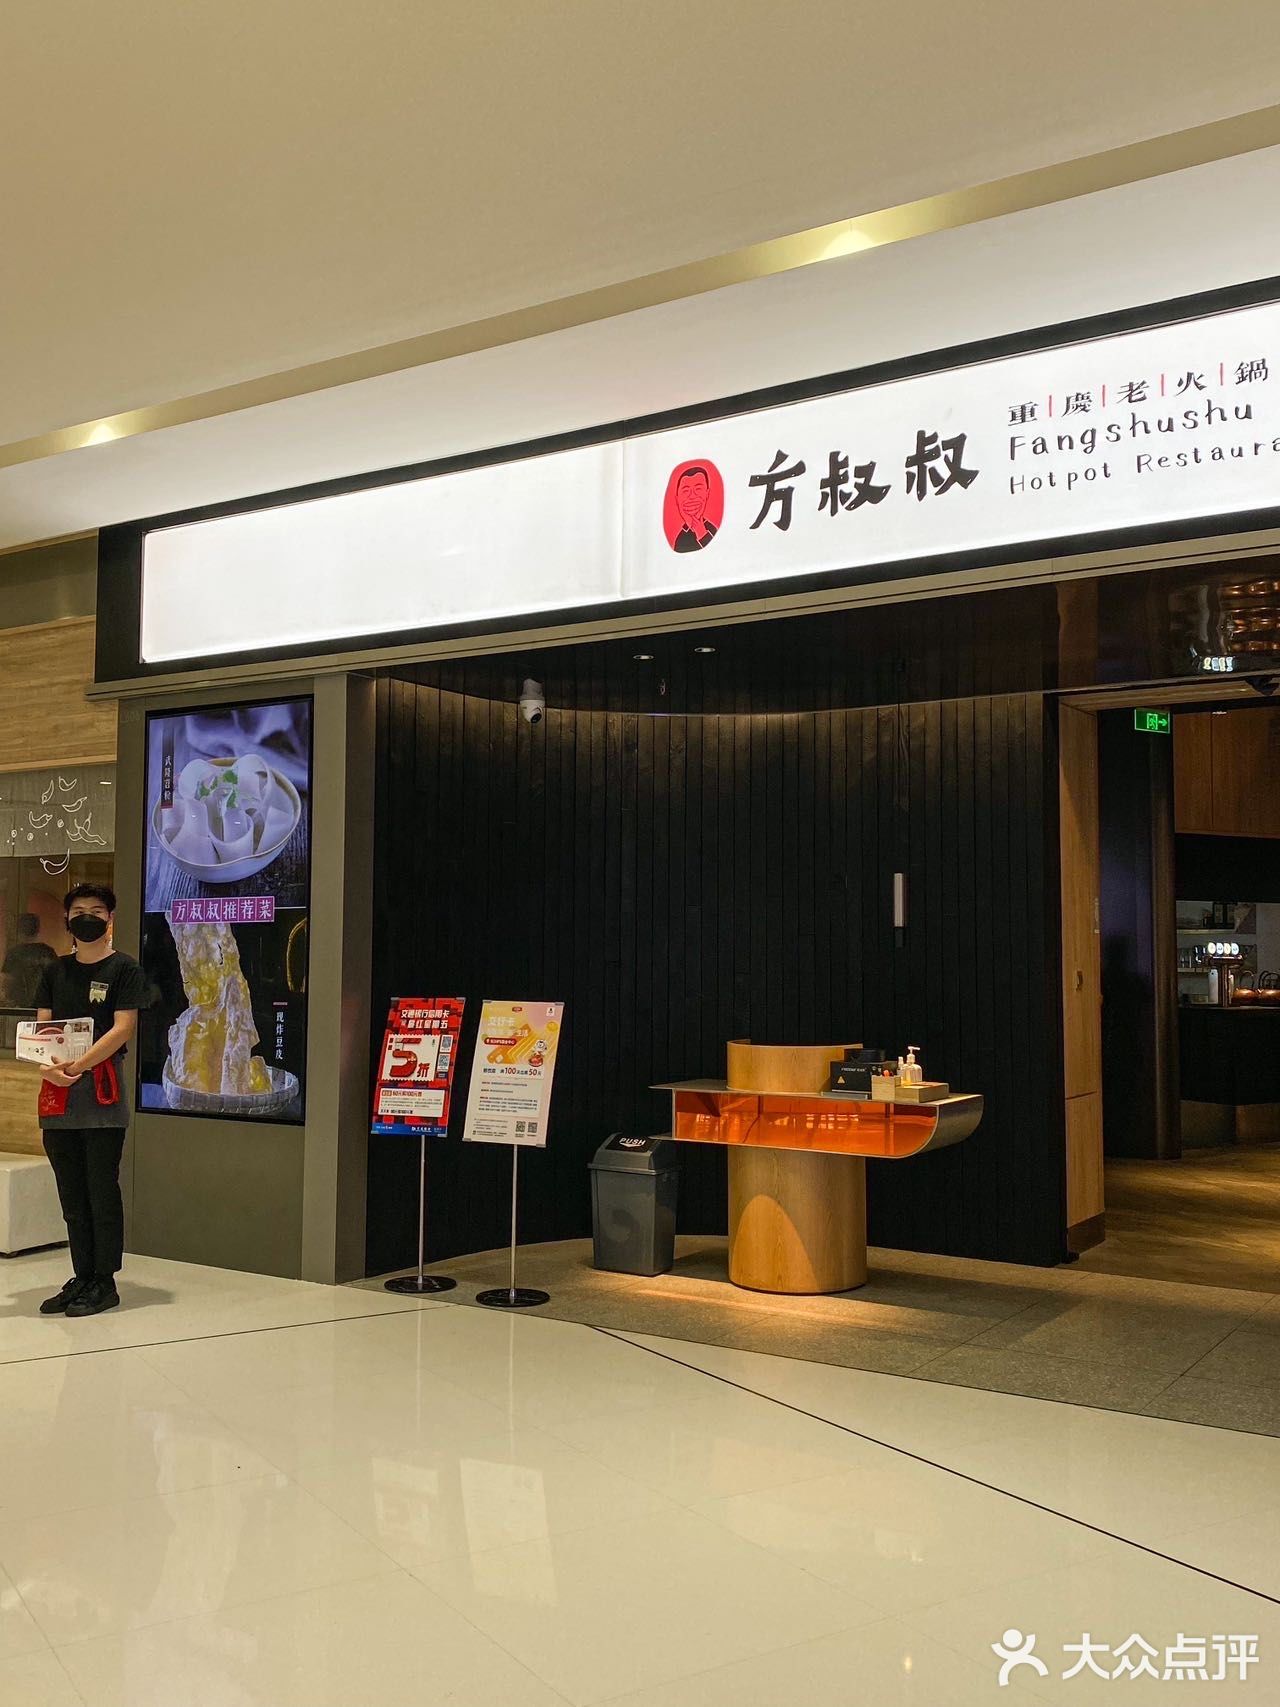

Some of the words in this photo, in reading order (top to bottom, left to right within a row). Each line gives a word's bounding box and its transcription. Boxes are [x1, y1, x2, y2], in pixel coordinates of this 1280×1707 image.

[1010, 399, 1253, 460] Fangshushu
[749, 429, 980, 531] 方叔叔
[174, 899, 272, 921] 方叔叔推荐菜
[619, 1137, 646, 1146] PUSH
